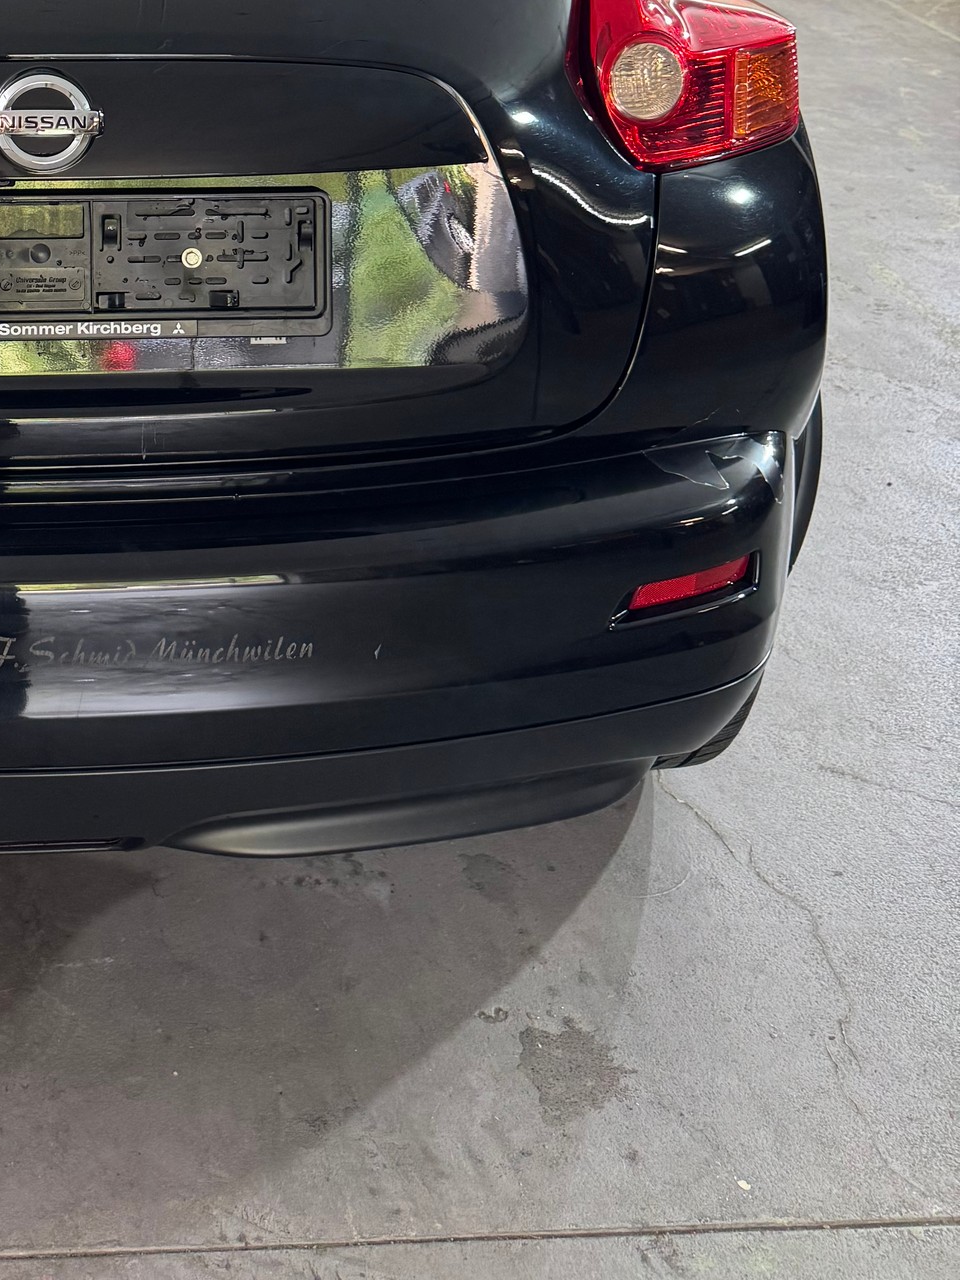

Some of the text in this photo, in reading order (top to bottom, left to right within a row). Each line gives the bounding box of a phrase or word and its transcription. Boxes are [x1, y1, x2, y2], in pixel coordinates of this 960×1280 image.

[0, 116, 87, 129] NISSAN
[77, 321, 162, 336] Kirchberg
[29, 635, 137, 666] Schmid
[152, 632, 314, 665] Münchwilen
